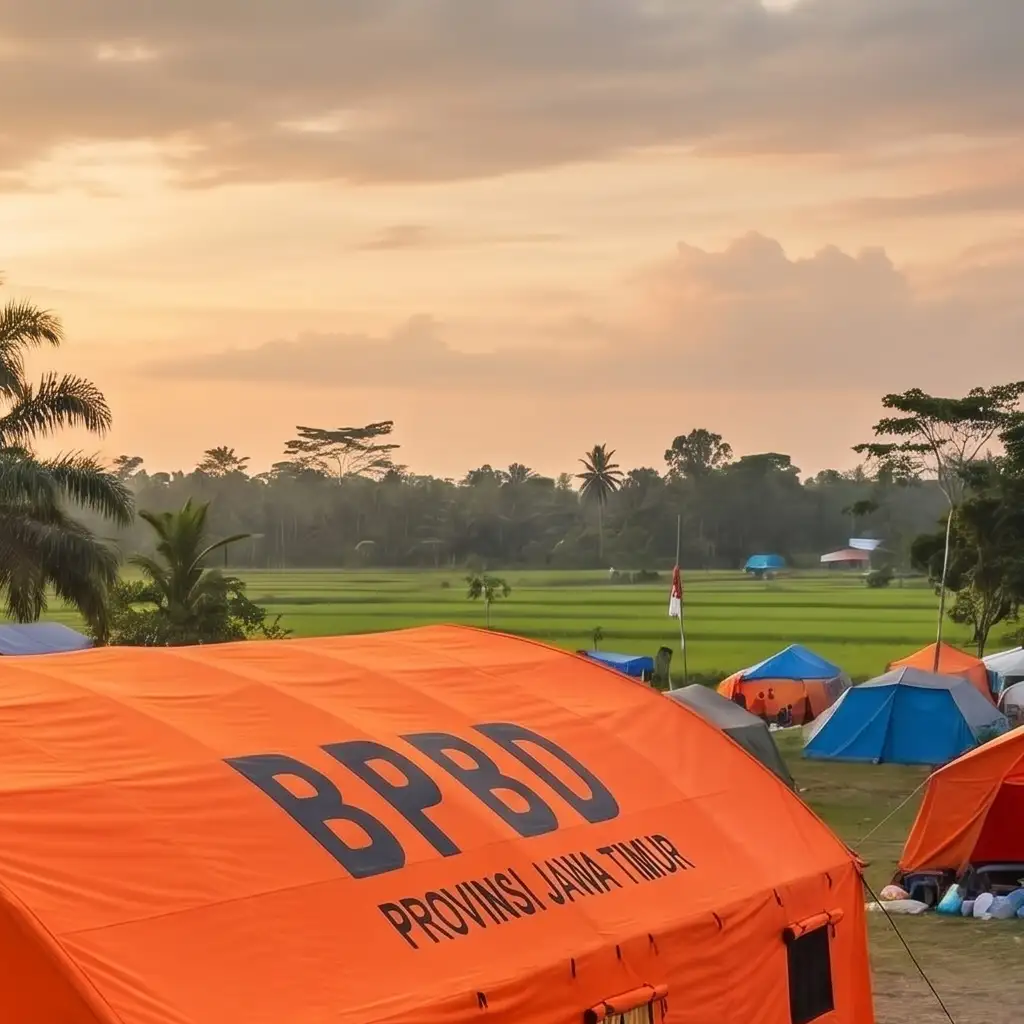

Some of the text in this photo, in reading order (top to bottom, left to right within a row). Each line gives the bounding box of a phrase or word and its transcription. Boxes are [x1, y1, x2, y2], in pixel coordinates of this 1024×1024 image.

[222, 722, 620, 879] BPBD
[377, 834, 695, 949] PROVINSI JAWA TIMUR
